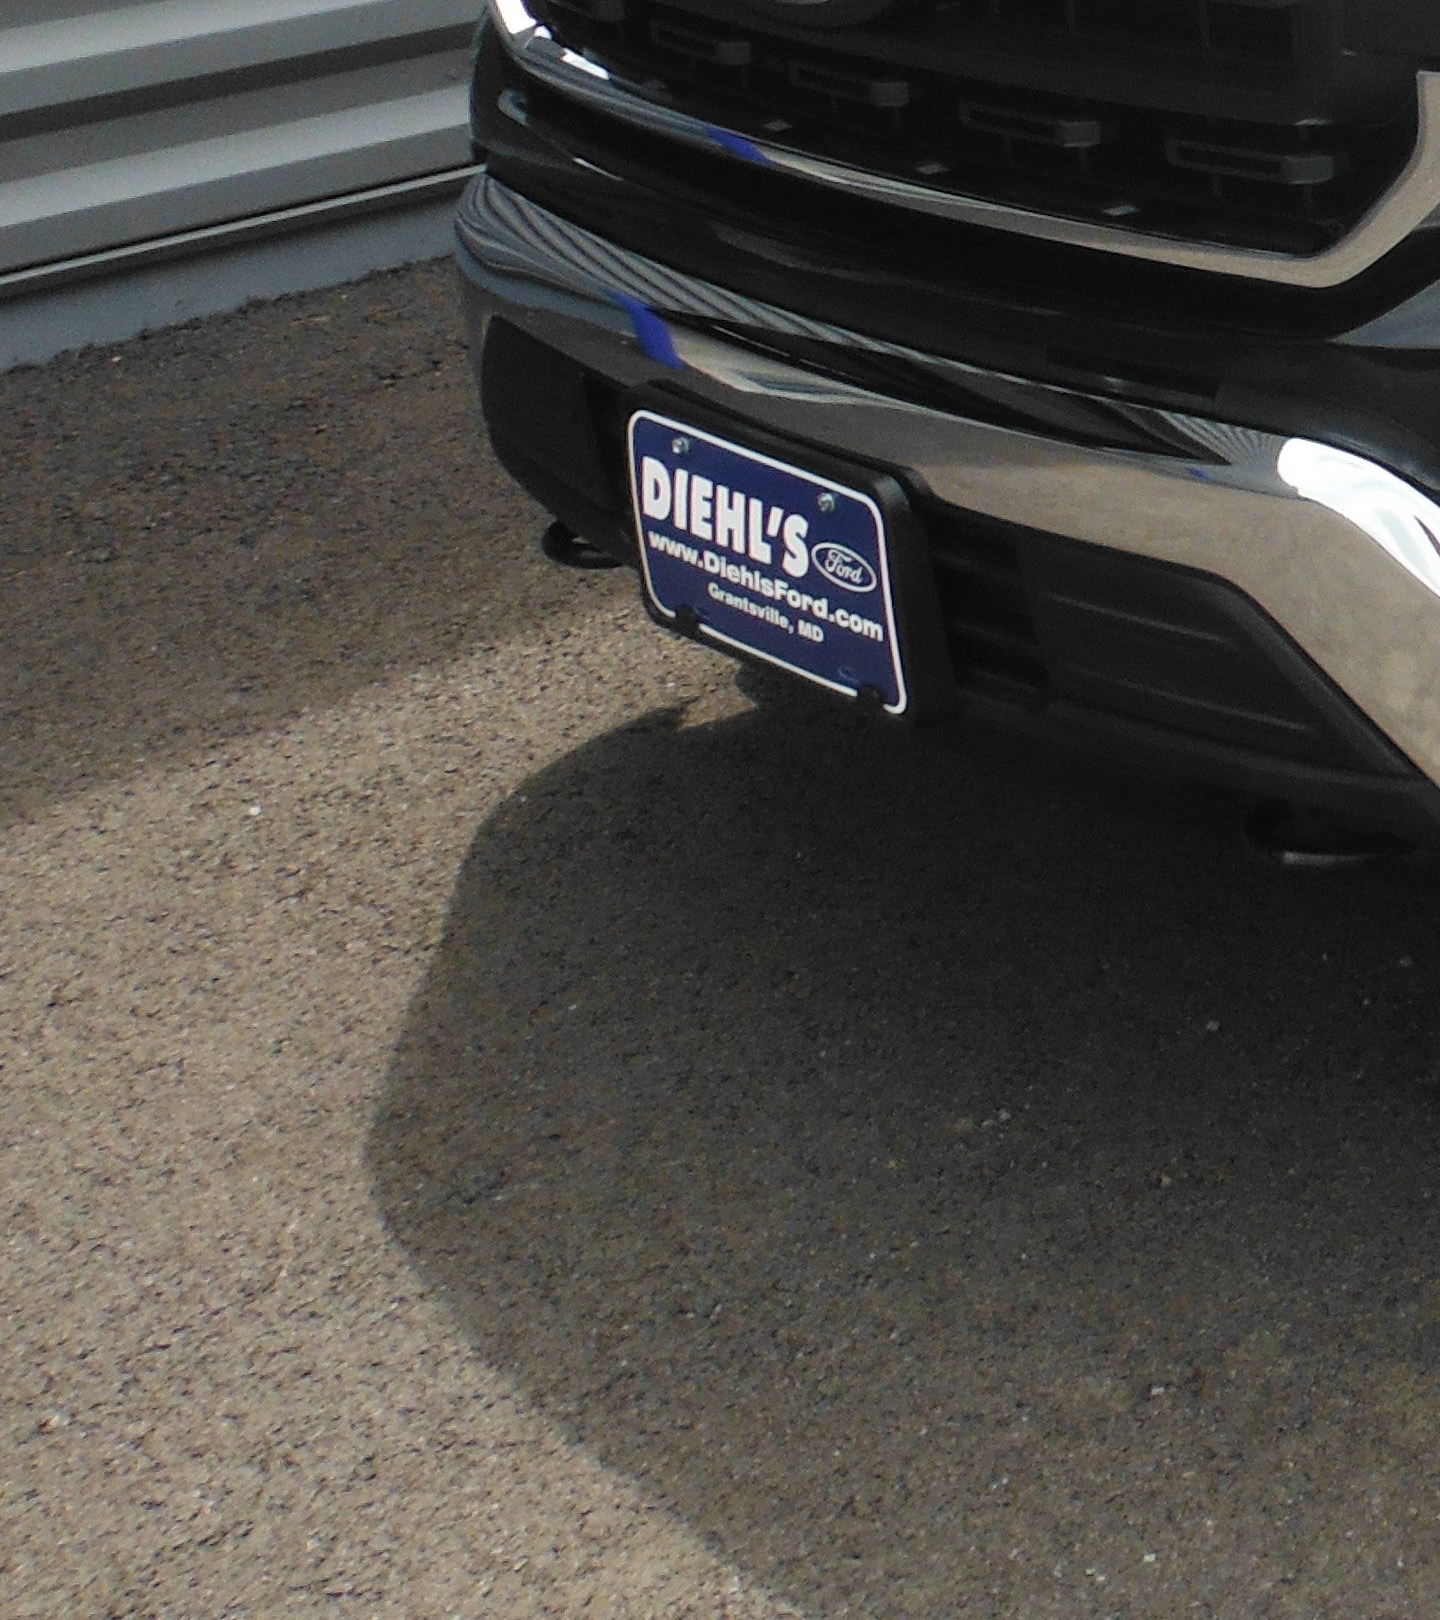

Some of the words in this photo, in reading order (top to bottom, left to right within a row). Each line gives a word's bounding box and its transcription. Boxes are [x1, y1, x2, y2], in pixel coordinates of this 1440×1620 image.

[641, 455, 811, 578] DIEHL'S
[647, 529, 884, 642] www.DiehlsFord.com
[824, 548, 863, 586] Ford
[706, 582, 794, 635] Grantsville,
[797, 619, 825, 643] MD
